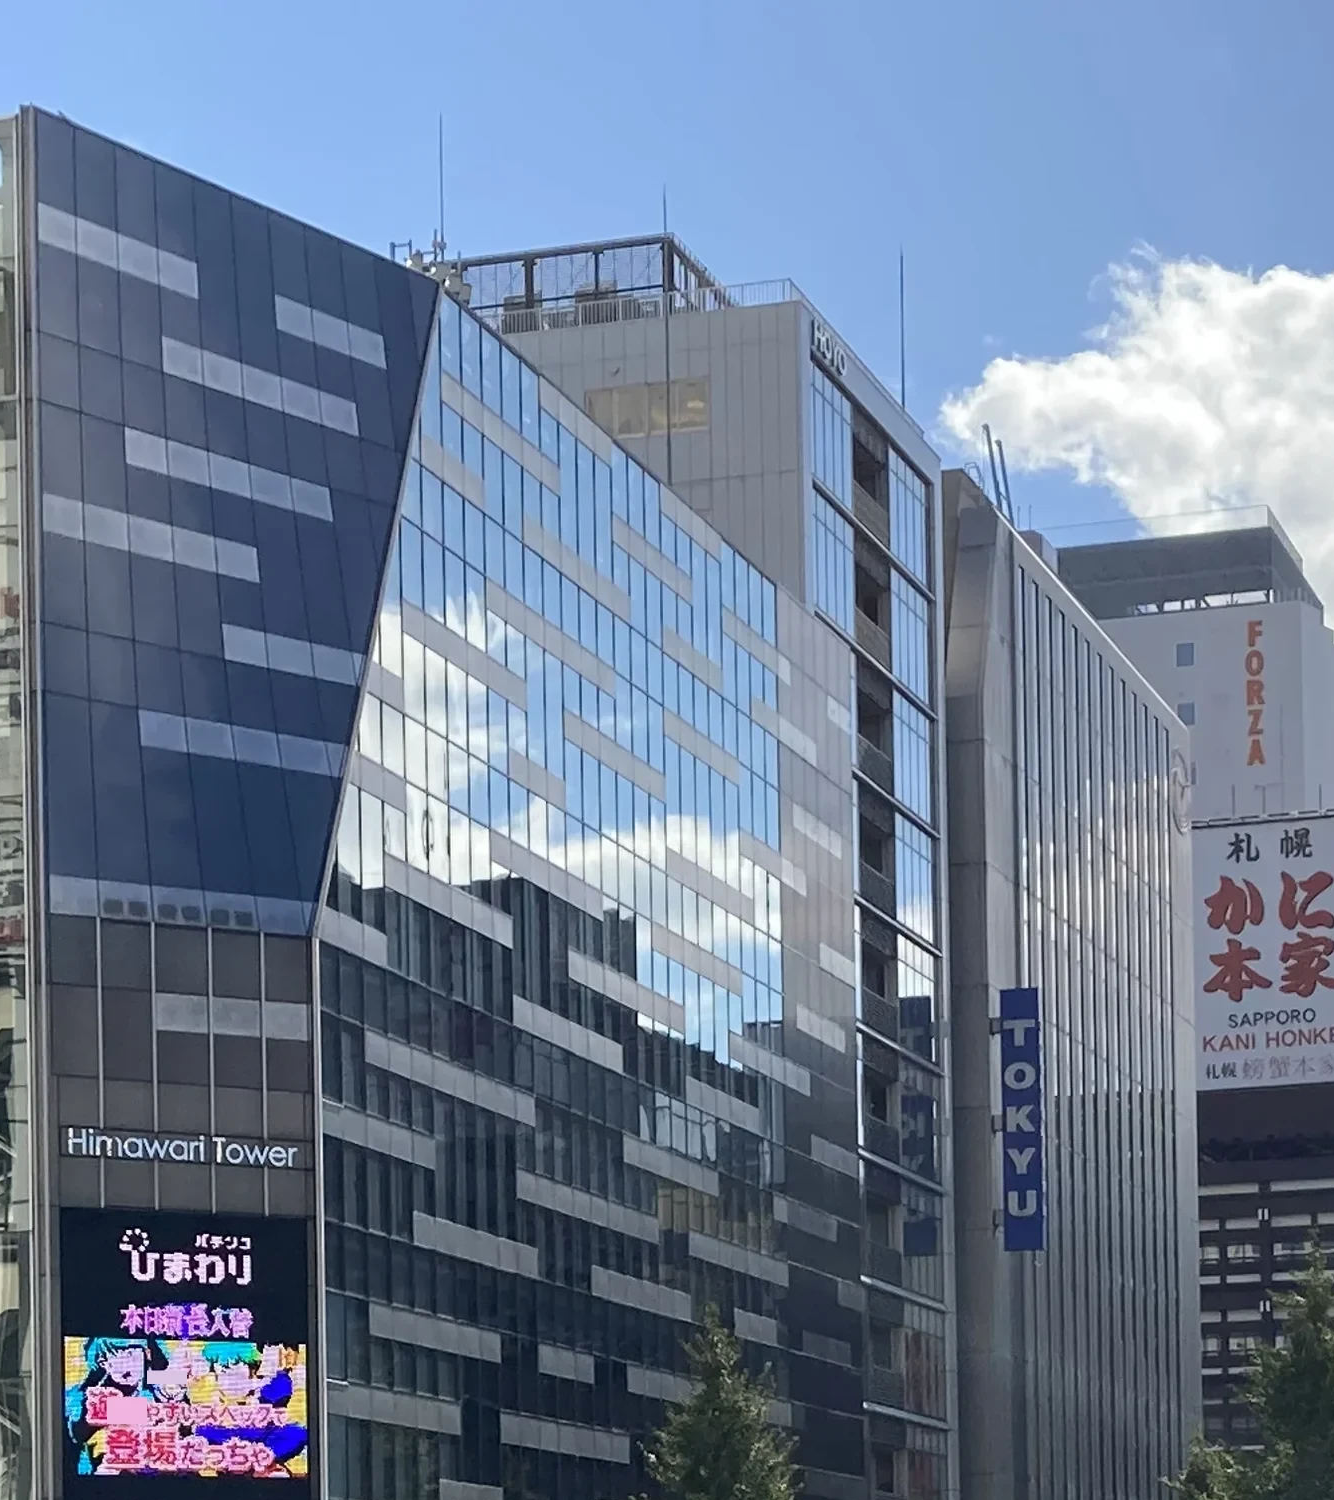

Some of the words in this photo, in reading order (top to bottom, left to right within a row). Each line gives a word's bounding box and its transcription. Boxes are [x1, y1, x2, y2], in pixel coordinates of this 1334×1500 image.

[1244, 618, 1267, 768] FORZA
[1226, 828, 1314, 865] 札幌
[1227, 1007, 1317, 1029] SAPPORO
[1201, 1029, 1258, 1052] KANI
[1002, 1017, 1037, 1218] TOKYU
[67, 1127, 206, 1164] Himawari
[212, 1136, 299, 1169] Tower
[194, 1232, 252, 1251] パチンコ
[119, 1240, 253, 1286] ひまわり
